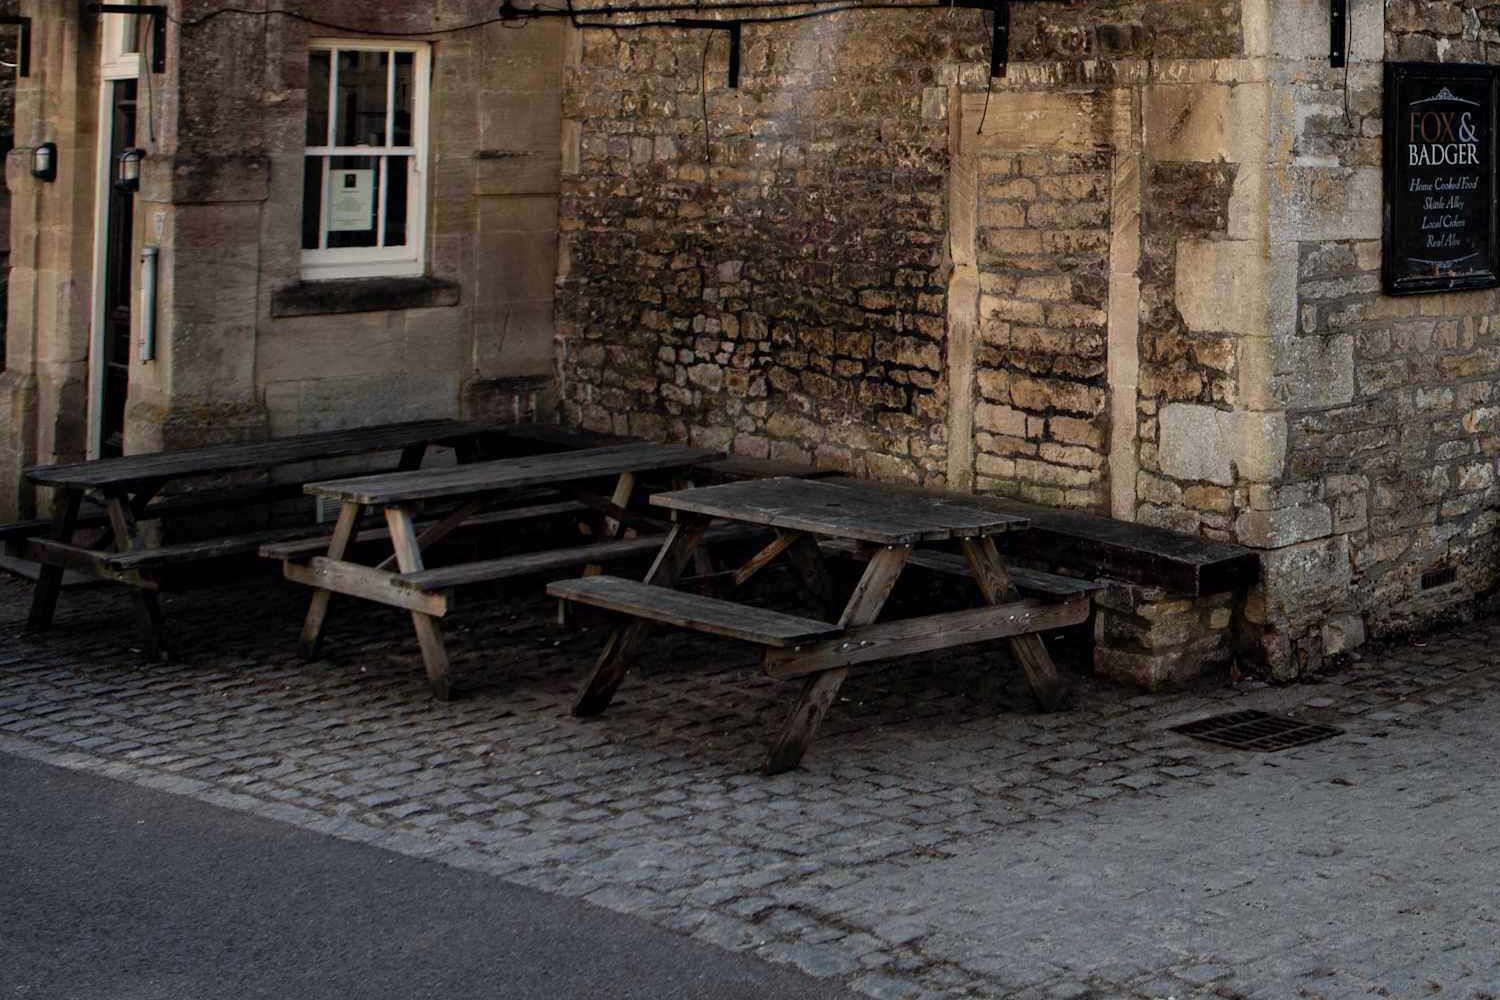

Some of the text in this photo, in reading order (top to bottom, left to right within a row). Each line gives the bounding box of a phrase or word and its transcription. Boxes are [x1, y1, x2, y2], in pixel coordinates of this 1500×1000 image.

[1408, 111, 1480, 144] FOX &
[1408, 143, 1481, 167] BADGER
[1409, 176, 1480, 192] Home Cooked Food
[1422, 215, 1443, 230] Local
[1426, 234, 1444, 248] Real
